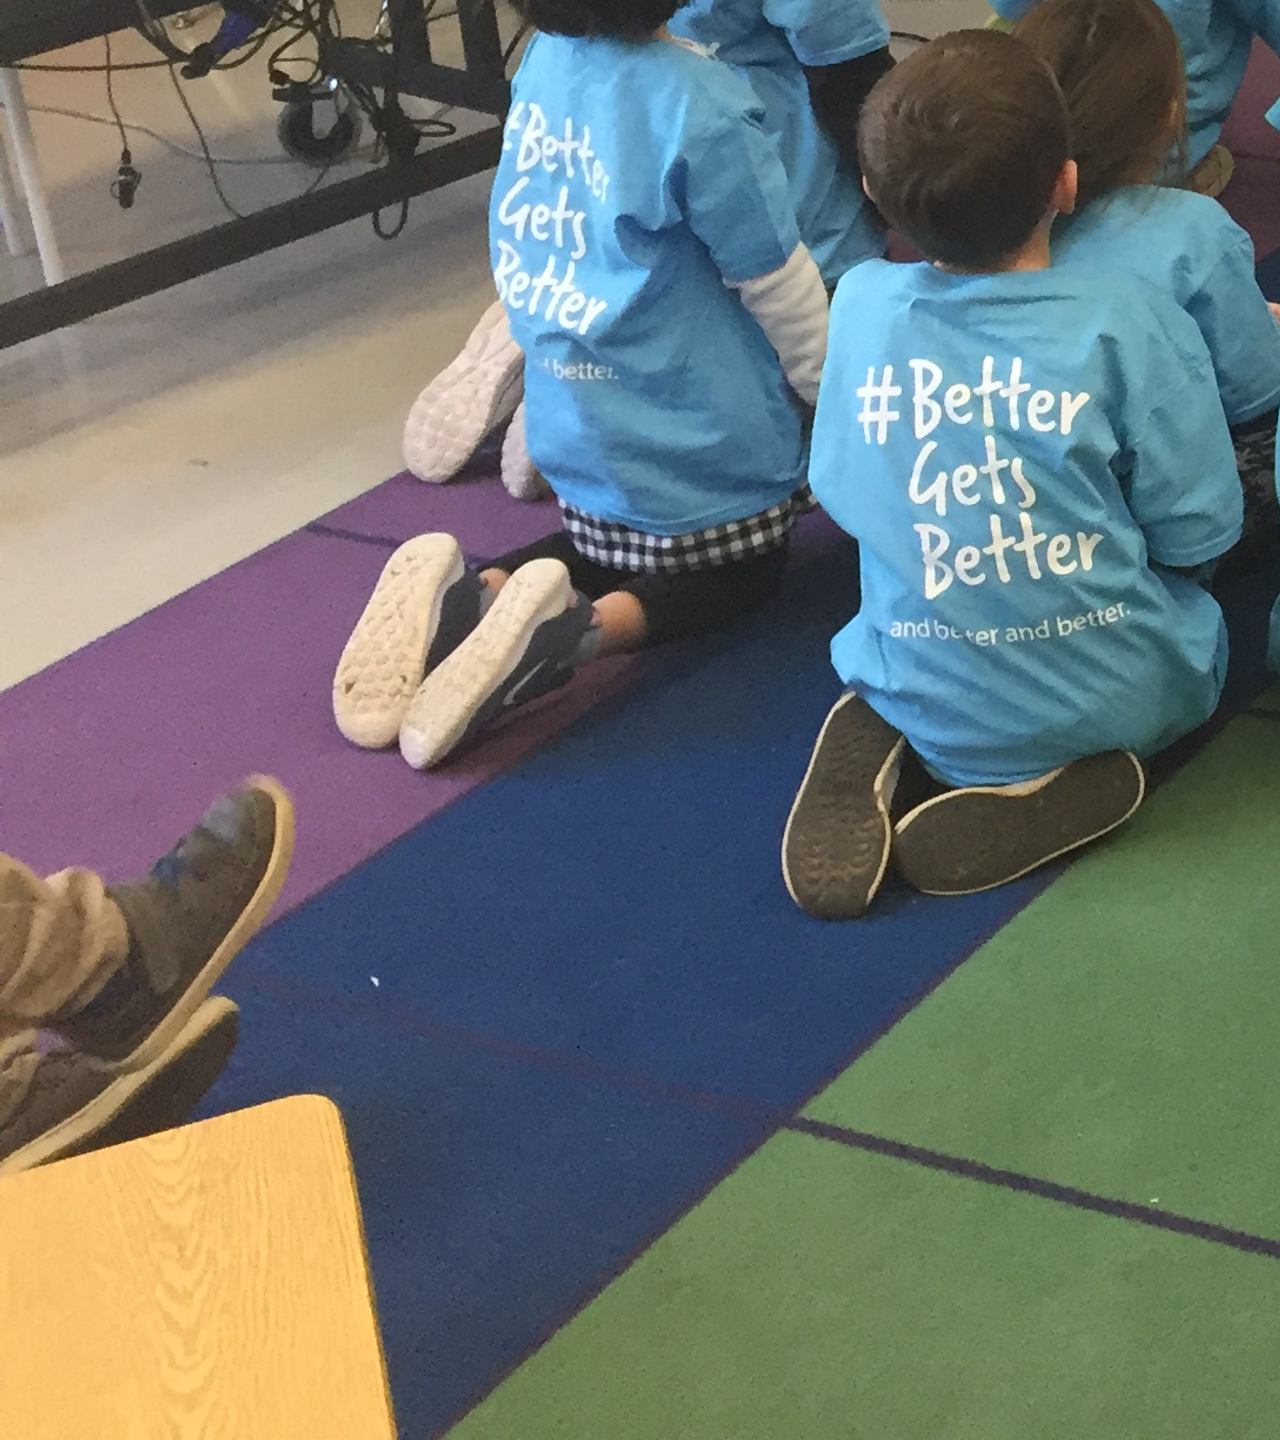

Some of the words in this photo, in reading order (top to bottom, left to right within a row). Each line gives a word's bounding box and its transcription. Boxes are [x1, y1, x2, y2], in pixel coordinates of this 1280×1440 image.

[498, 176, 587, 259] Gets
[494, 238, 608, 335] Better
[856, 355, 1090, 445] #Better
[908, 435, 1037, 517] Gets
[913, 512, 1105, 600] Better
[889, 618, 931, 638] and
[1004, 619, 1050, 643] and
[1056, 601, 1132, 637] better.
